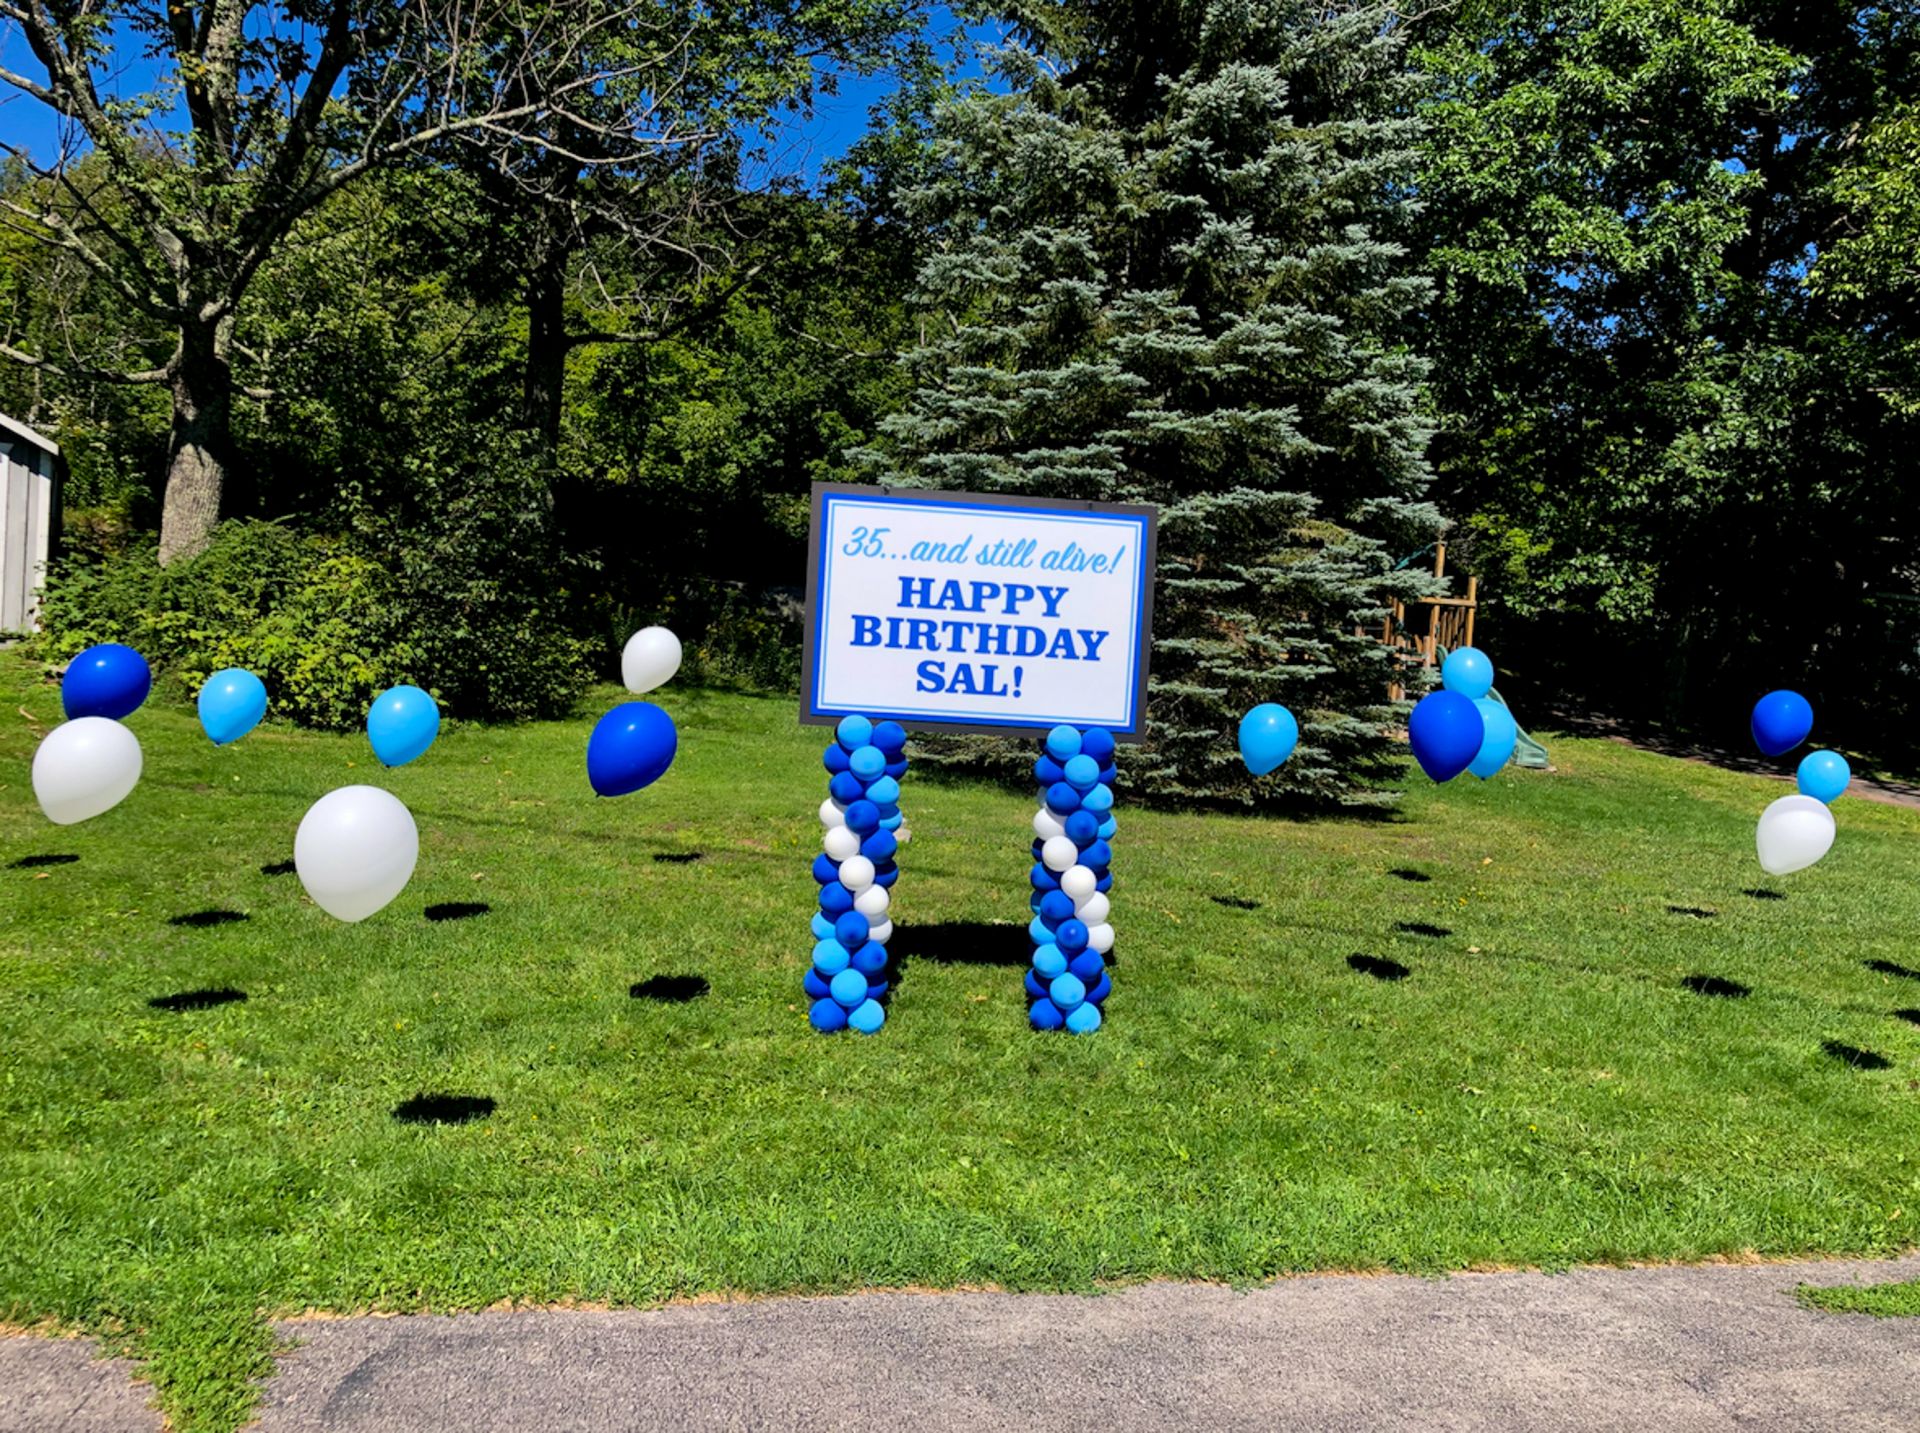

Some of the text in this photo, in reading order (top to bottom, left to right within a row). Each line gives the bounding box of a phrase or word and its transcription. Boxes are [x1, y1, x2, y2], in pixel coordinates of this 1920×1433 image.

[975, 538, 1037, 568] still
[1040, 541, 1126, 574] alive!
[897, 576, 1069, 618] HAPPY
[850, 614, 1109, 661] BIRTHDAY
[916, 660, 1024, 698] SAL!
